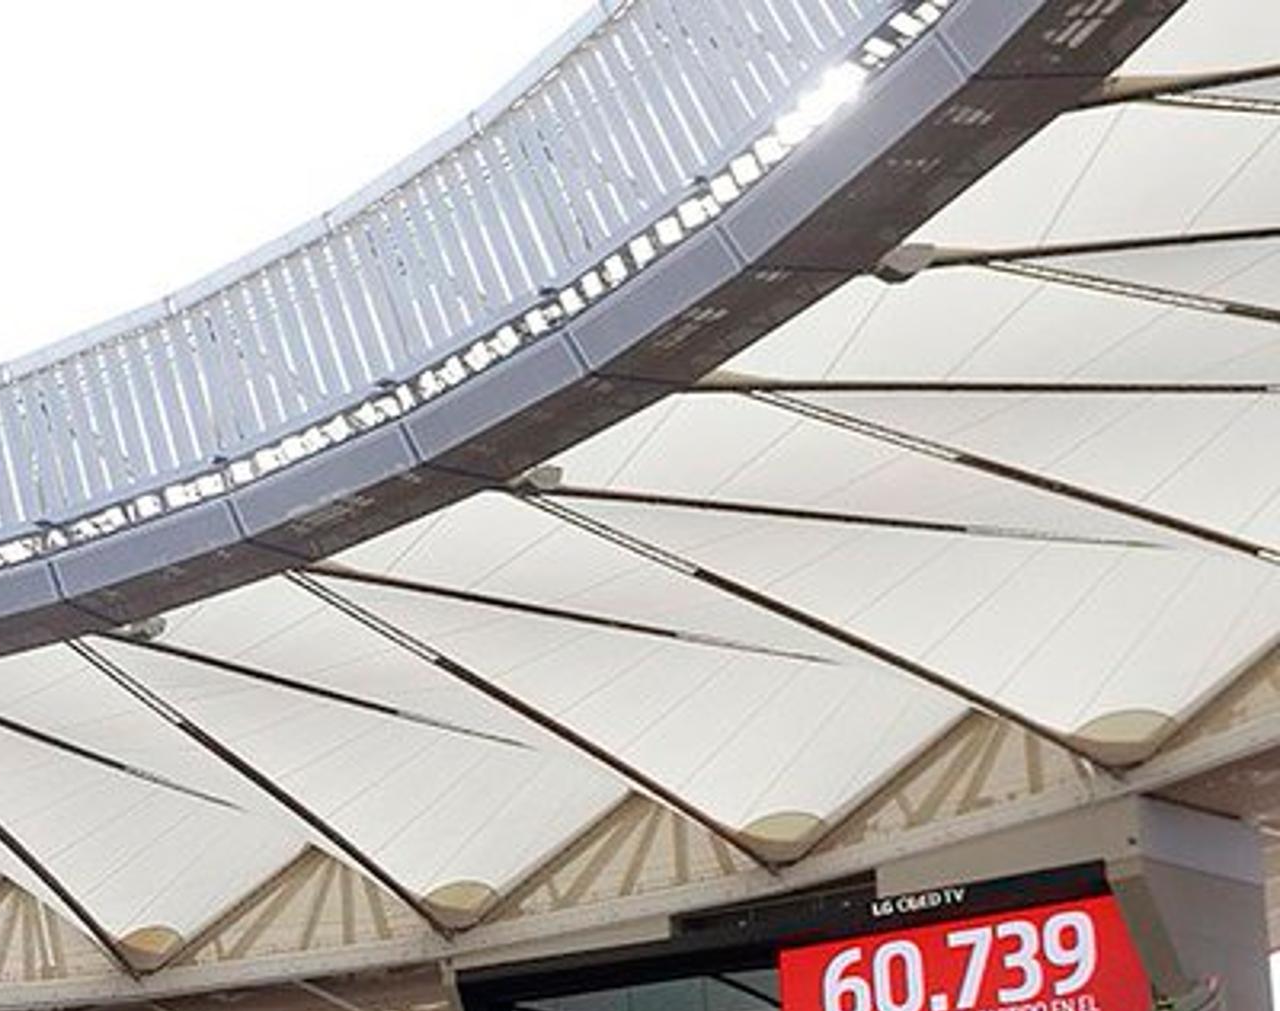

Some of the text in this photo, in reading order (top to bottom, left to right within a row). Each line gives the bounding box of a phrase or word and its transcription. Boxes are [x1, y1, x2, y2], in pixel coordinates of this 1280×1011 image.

[871, 888, 965, 917] LG OLED TV
